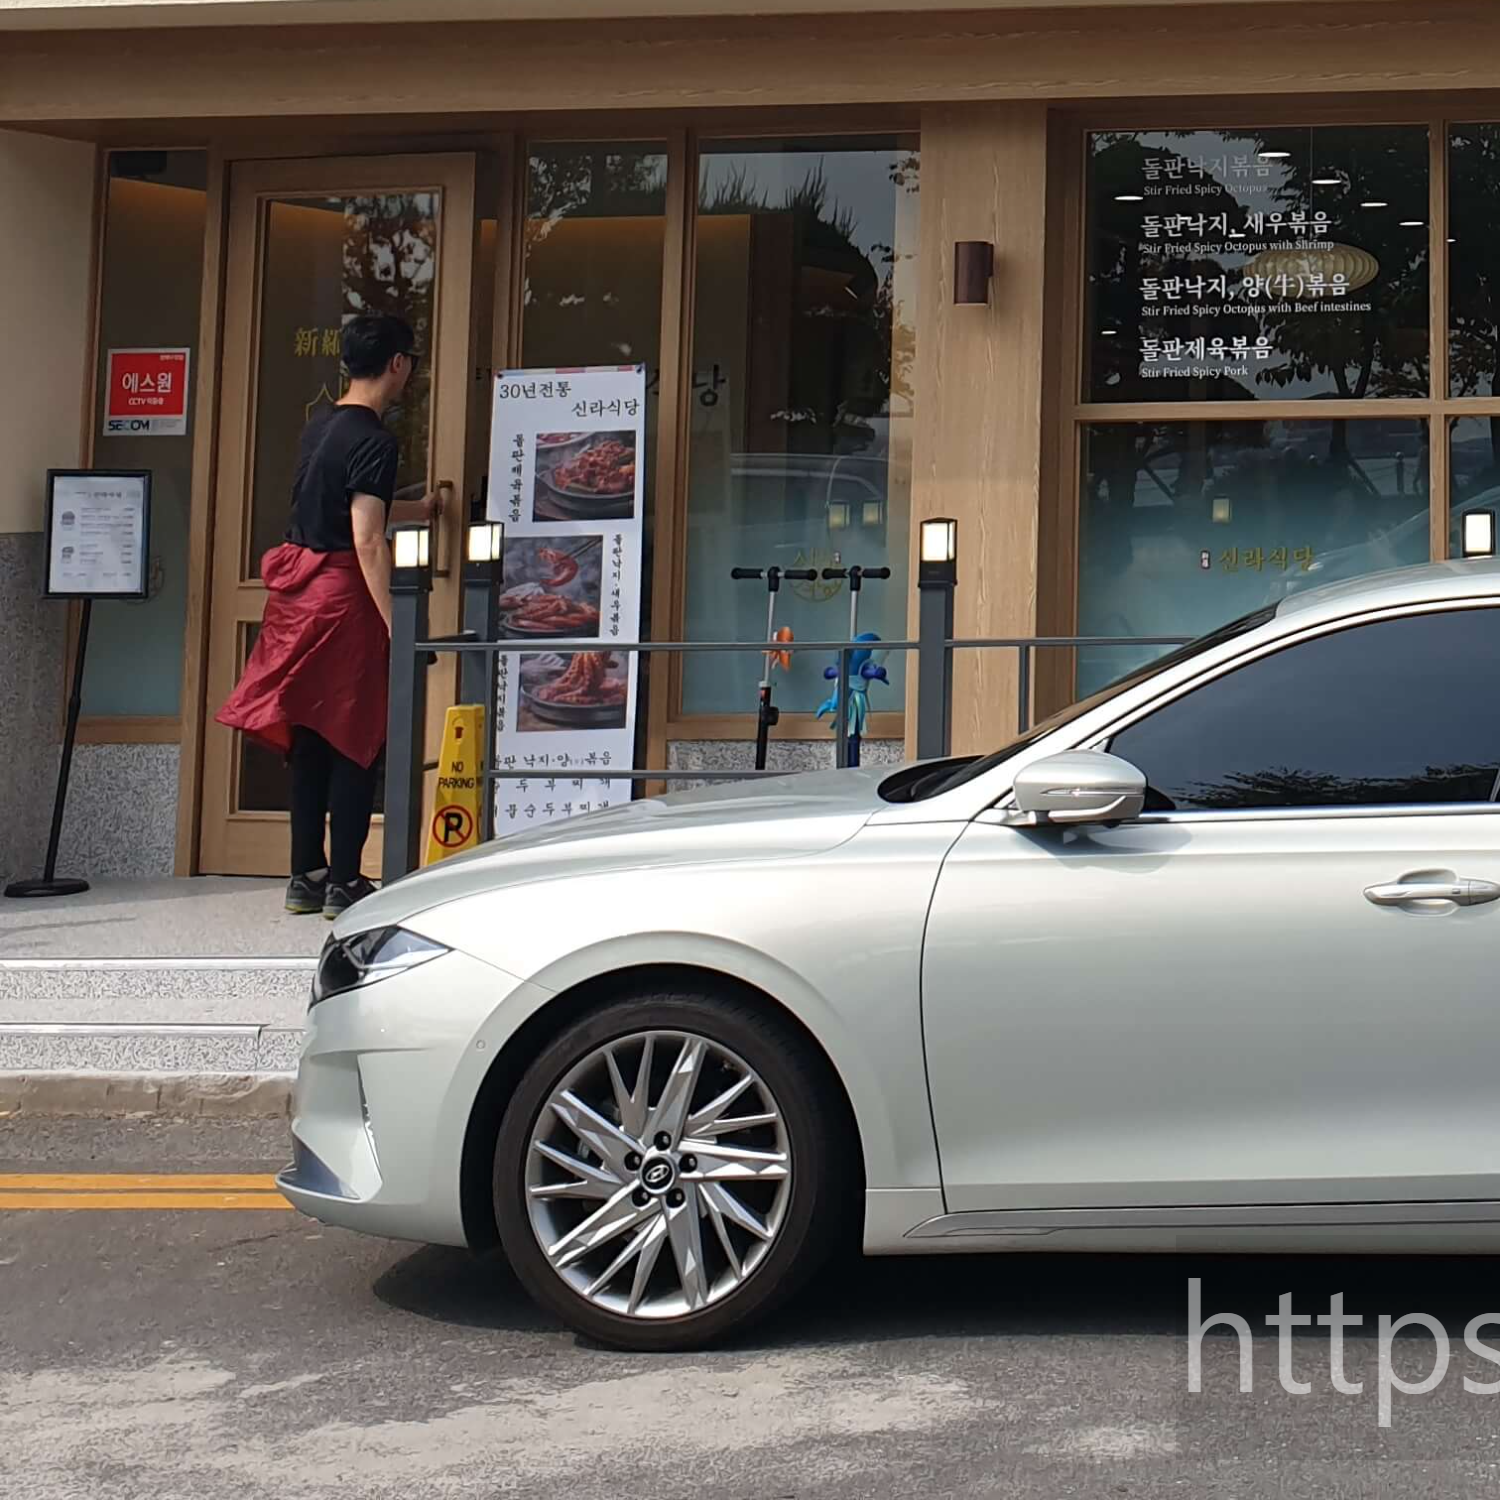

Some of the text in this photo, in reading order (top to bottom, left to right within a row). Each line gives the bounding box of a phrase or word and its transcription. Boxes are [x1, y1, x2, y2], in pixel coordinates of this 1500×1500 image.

[1141, 154, 1273, 180] 돌판낙지볶음
[1143, 185, 1162, 196] Stir
[1165, 184, 1192, 195] Fried
[1194, 183, 1222, 197] Spicy
[1243, 211, 1332, 235] 새우볶음
[1143, 239, 1335, 255] Stir Fried Spicy Octopus with Shrimp
[1141, 300, 1371, 317] Stir Fried Spicy Octopus with Beef intestines
[1139, 335, 1274, 362] 돌판제육볶음
[1141, 364, 1249, 380] Stir Fried Spicy Pork
[122, 371, 173, 394] 에스원
[571, 399, 640, 418] 신라식당
[451, 761, 464, 773] NO
[437, 777, 475, 789] PARKING
